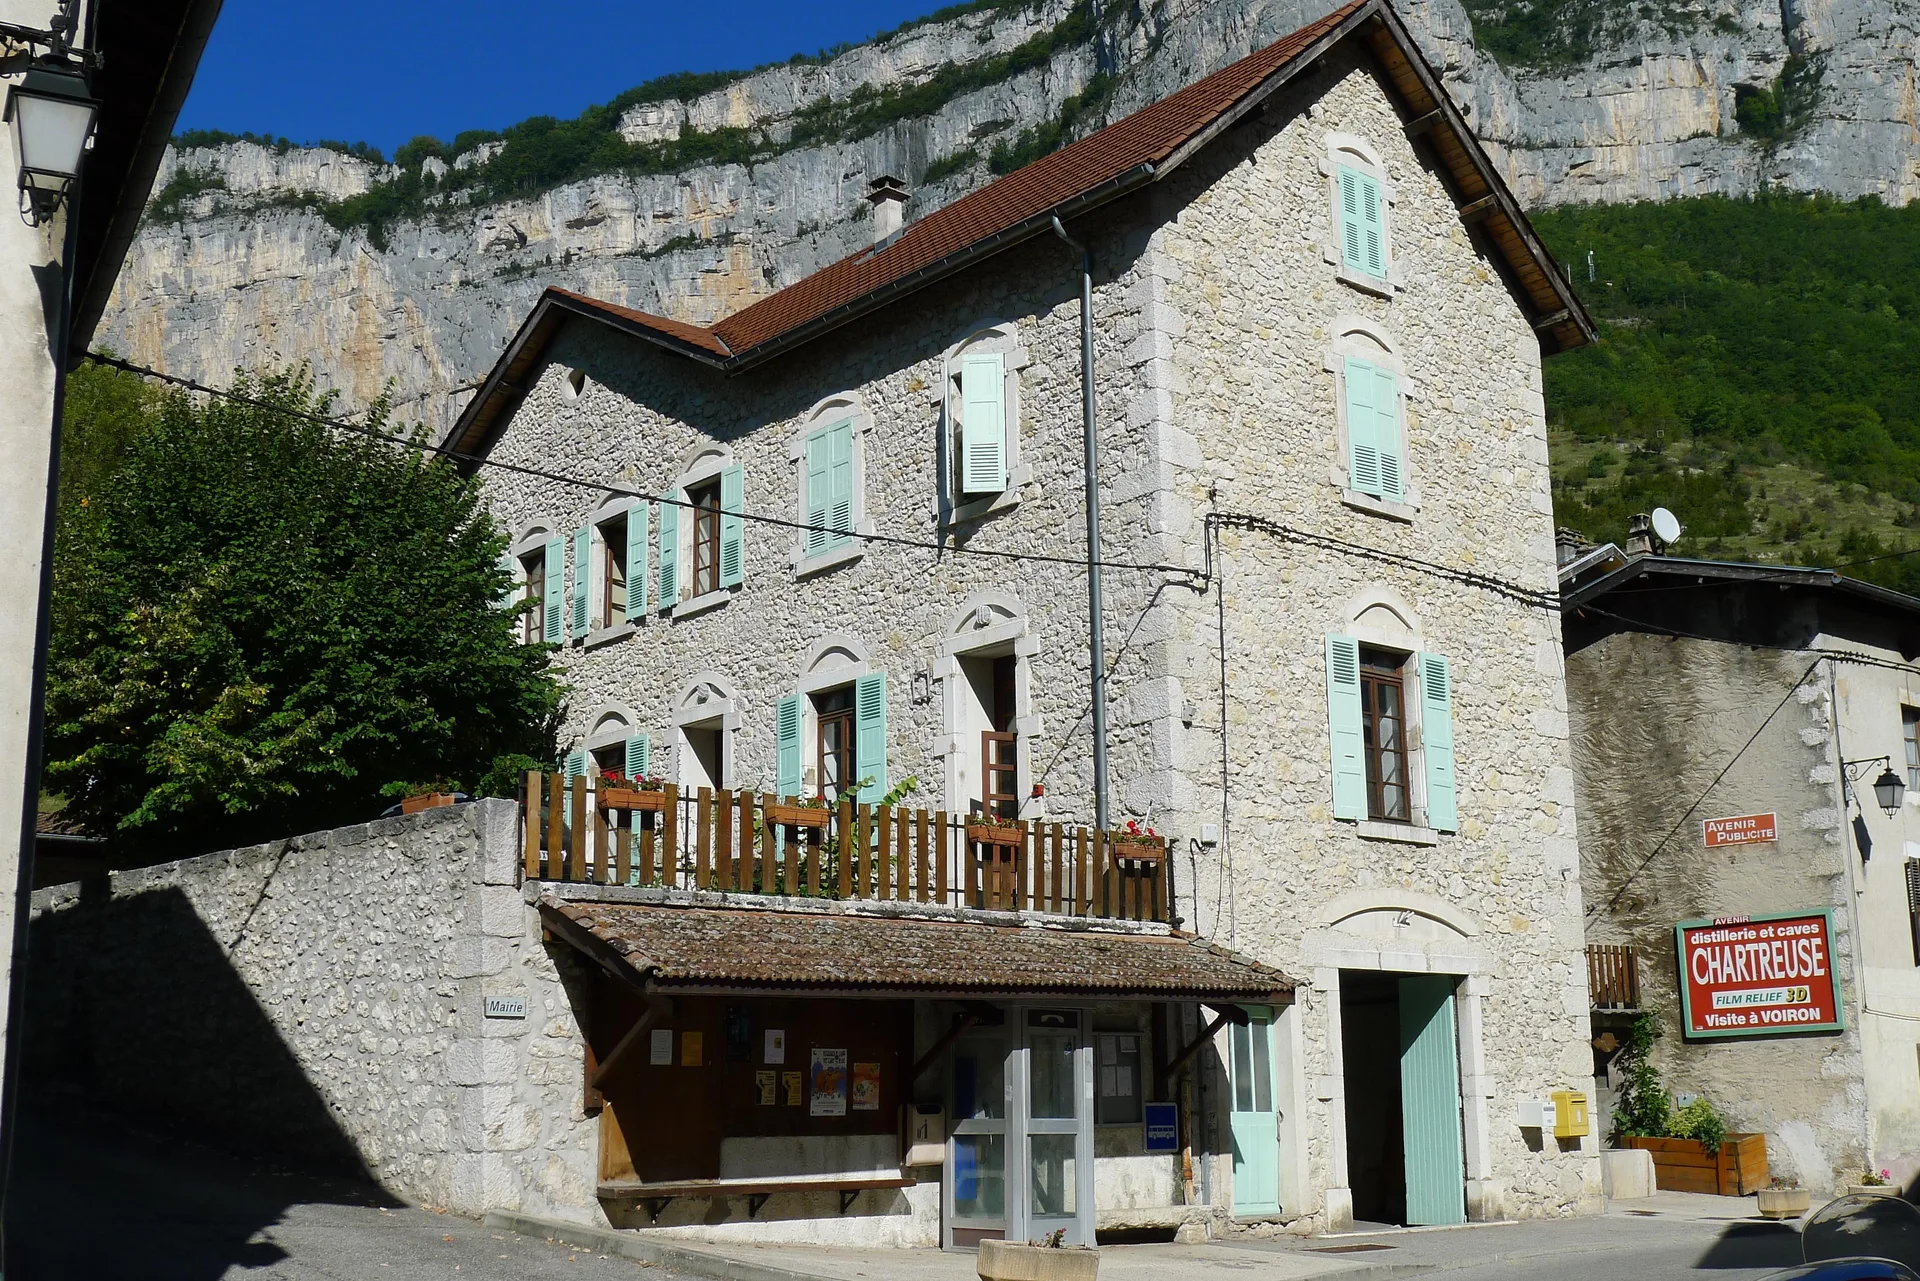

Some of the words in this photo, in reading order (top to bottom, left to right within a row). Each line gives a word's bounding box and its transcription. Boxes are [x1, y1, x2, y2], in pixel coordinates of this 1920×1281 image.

[1708, 819, 1756, 832] AVENIR
[1717, 829, 1773, 842] PUBLICITE
[1715, 915, 1750, 925] AVENIR
[1691, 928, 1757, 944] distillerie
[1759, 926, 1774, 938] et
[1777, 923, 1819, 937] caves
[1692, 938, 1825, 985] CHARTREUSE
[1716, 995, 1742, 1006] FILM
[1746, 992, 1782, 1003] RELIEF
[1786, 987, 1808, 1003] 3D
[489, 1001, 523, 1012] Mairie
[1705, 1013, 1746, 1027] Visite
[1749, 1012, 1759, 1024] à
[1760, 1008, 1821, 1024] VOIRON
